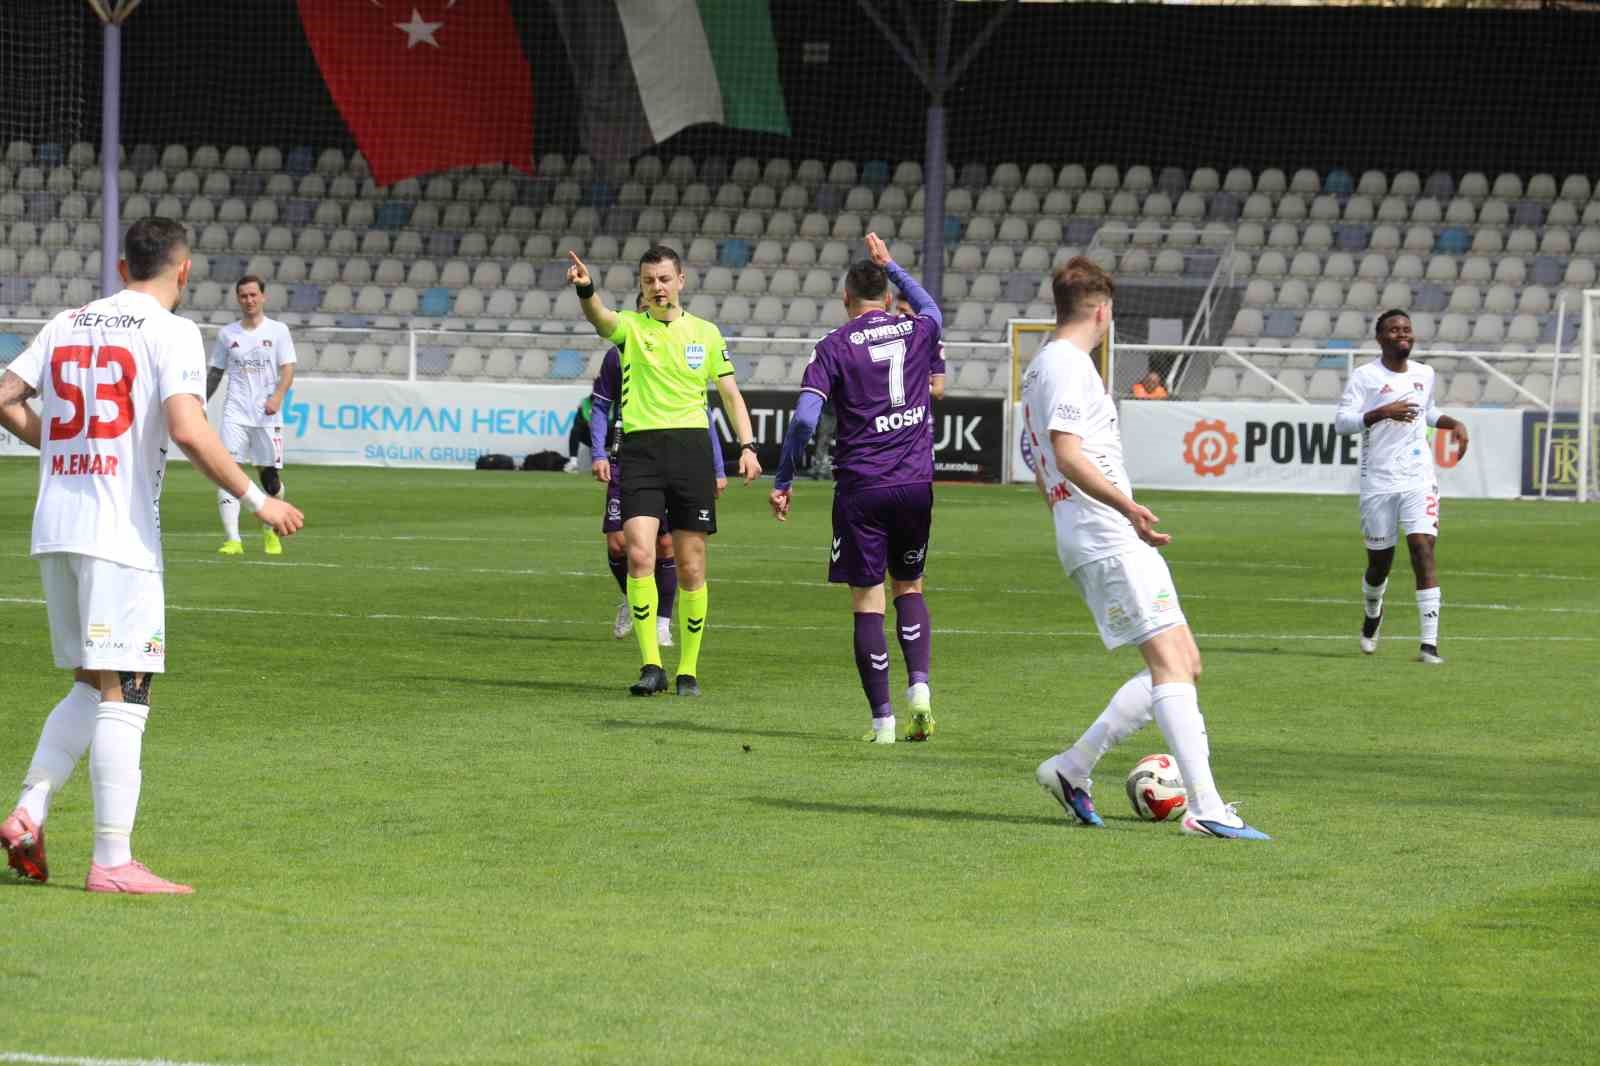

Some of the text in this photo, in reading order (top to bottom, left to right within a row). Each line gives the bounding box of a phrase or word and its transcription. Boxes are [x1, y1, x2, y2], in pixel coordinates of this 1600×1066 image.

[73, 312, 145, 329] REFORM
[686, 344, 704, 353] FIFA
[868, 339, 907, 408] 7
[49, 344, 137, 441] 53
[318, 404, 462, 433] LOKMAN
